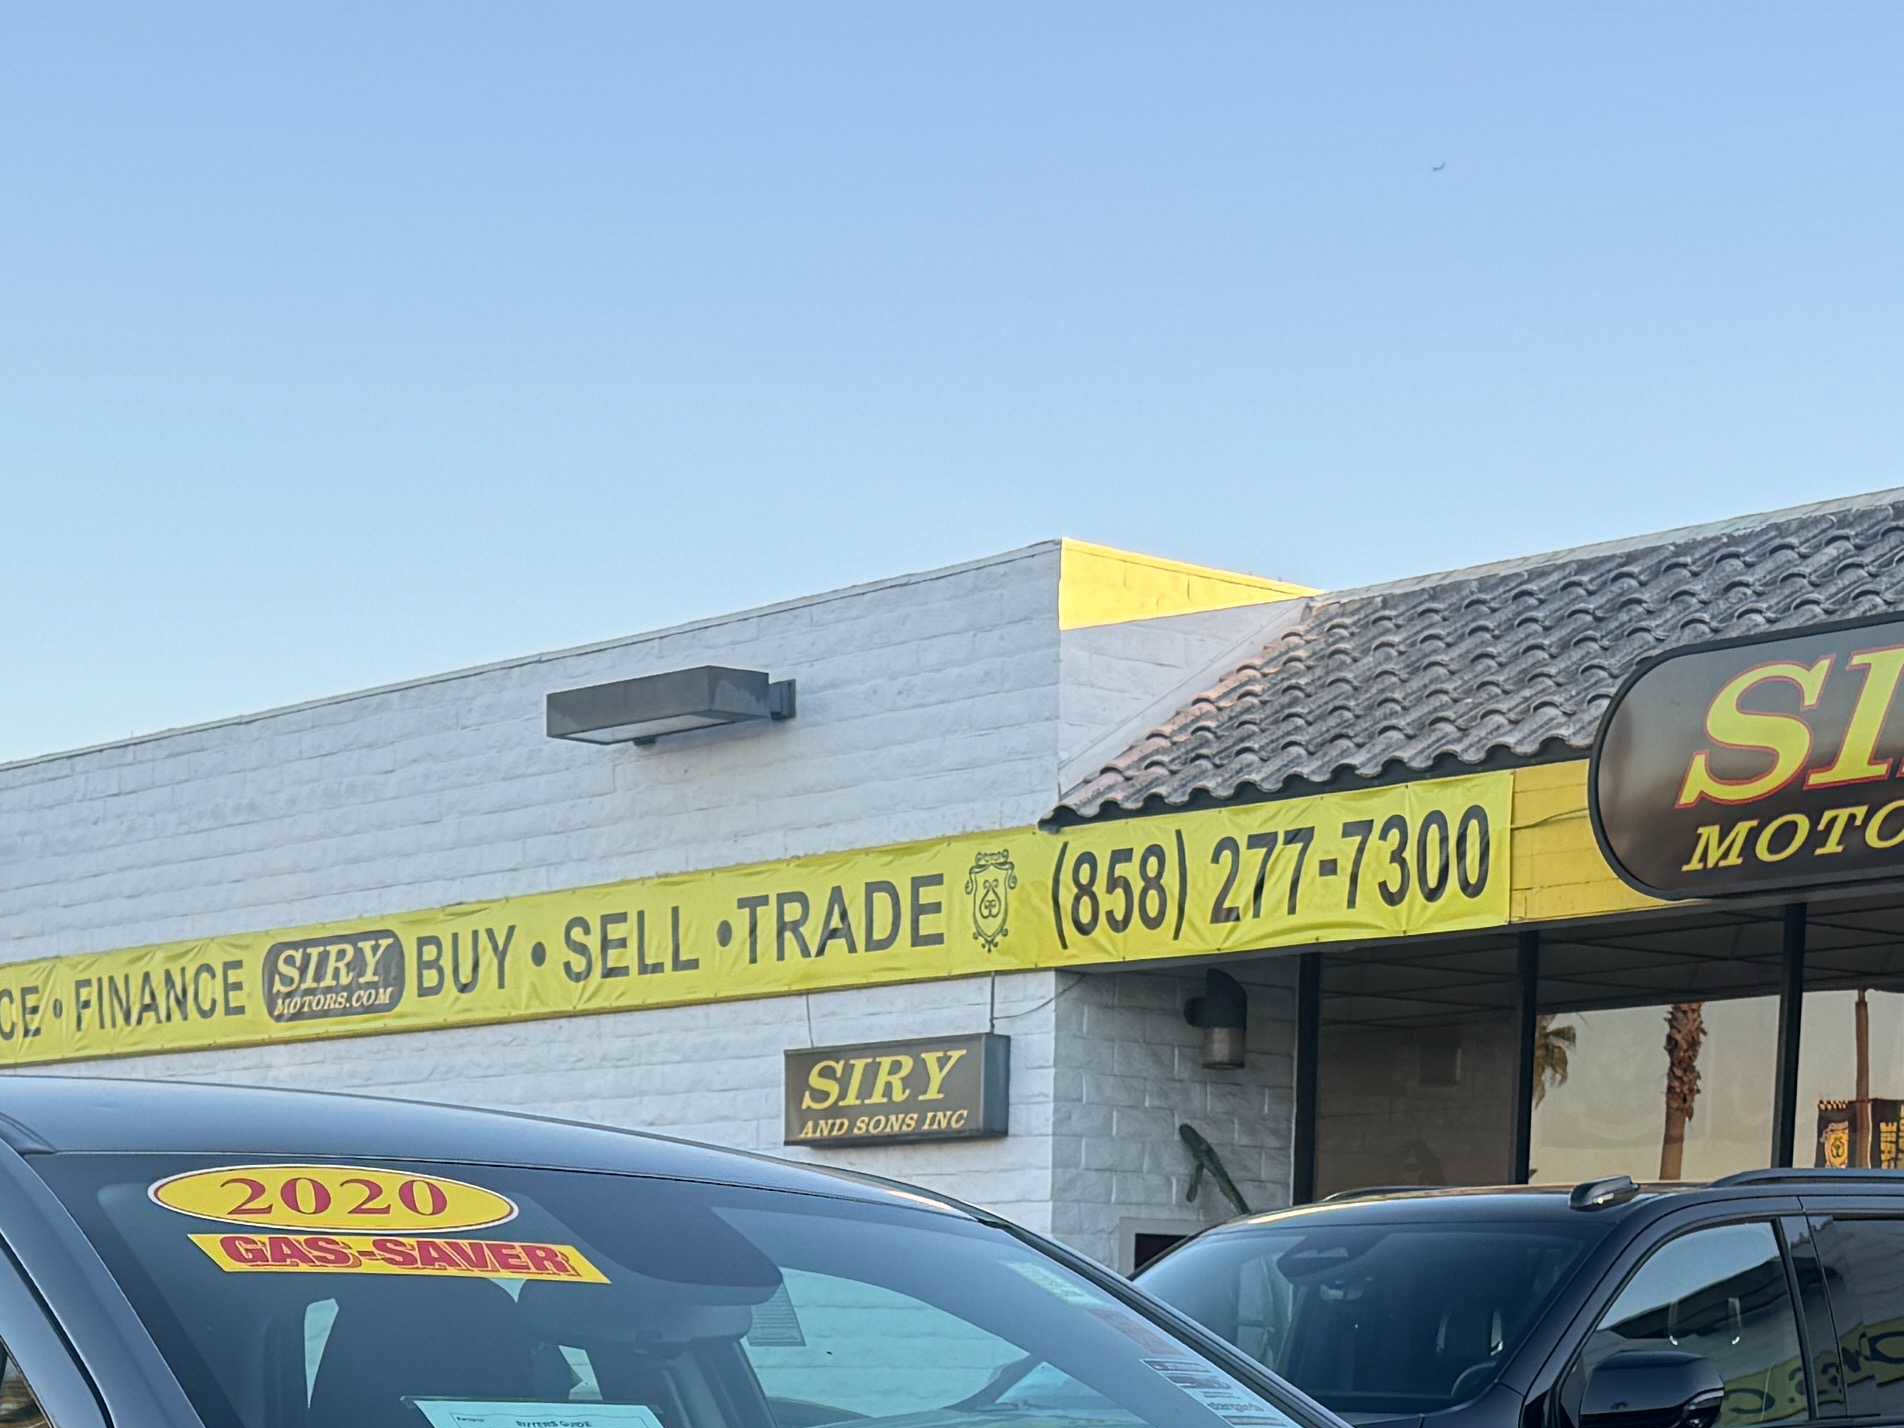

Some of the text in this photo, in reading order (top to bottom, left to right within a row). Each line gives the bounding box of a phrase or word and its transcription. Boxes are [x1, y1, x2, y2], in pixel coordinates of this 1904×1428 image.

[1052, 804, 1490, 950] (858) 277-7300
[416, 873, 945, 998] BUY SELL TRADE
[272, 937, 393, 994] SIRY
[74, 960, 246, 1032] FINANCE
[274, 987, 393, 1016] MOTORS.COM
[801, 1048, 967, 1110] SIRY
[799, 1109, 968, 1139] AND SONS INC
[220, 1177, 448, 1217] 2020
[219, 1235, 583, 1277] GAS-SAVER
